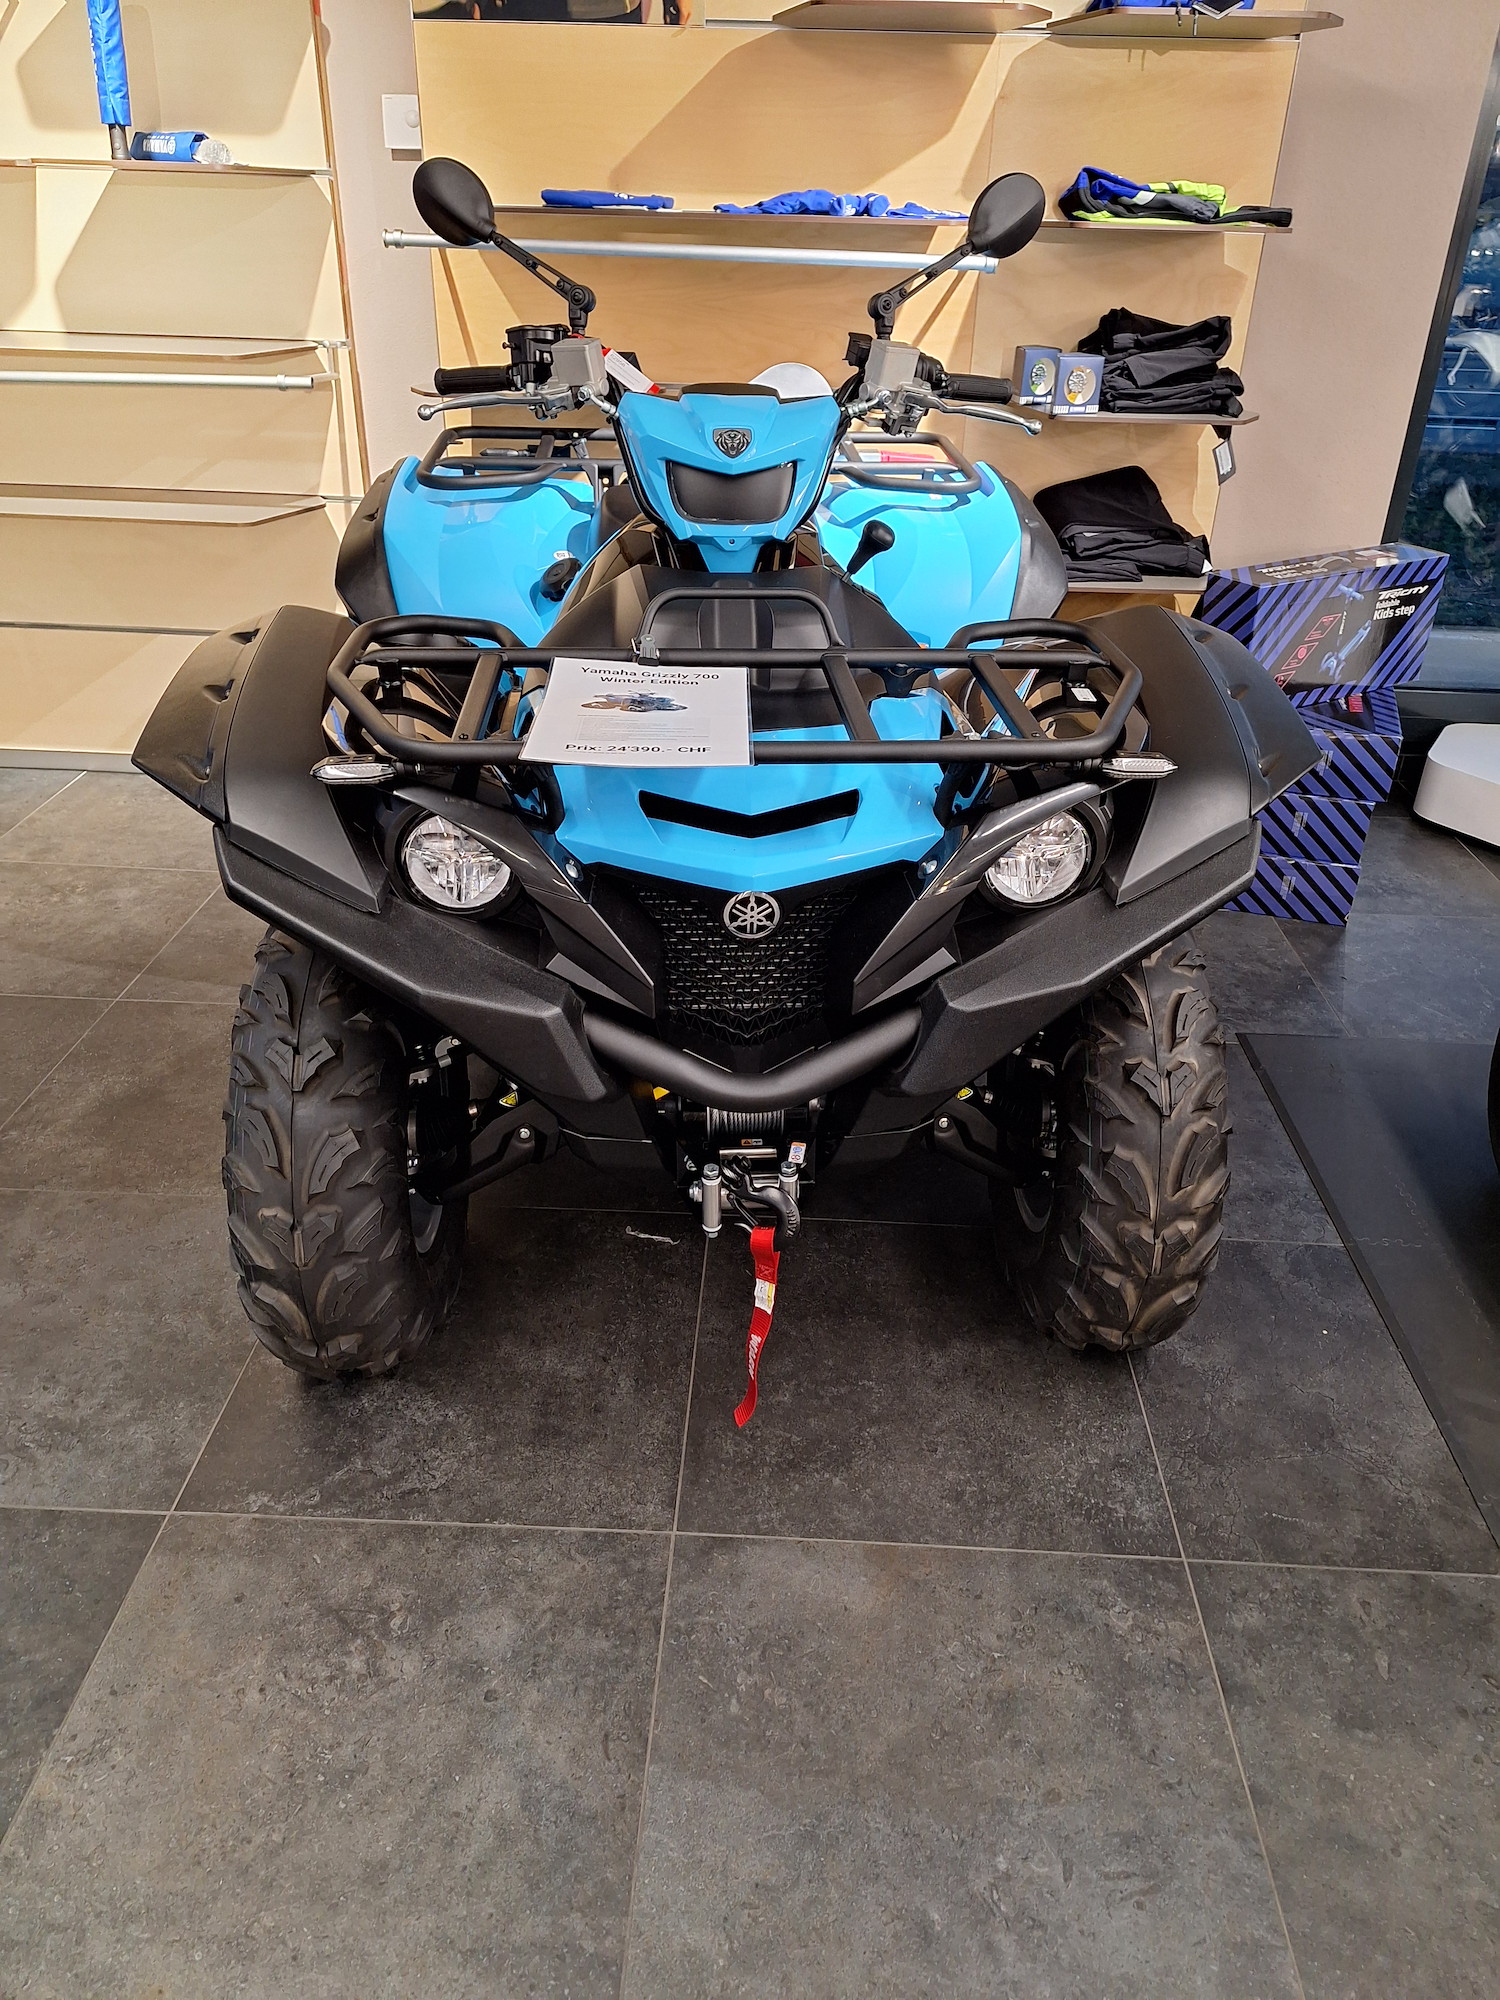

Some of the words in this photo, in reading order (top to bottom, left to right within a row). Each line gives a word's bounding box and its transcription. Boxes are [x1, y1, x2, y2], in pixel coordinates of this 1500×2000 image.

[1373, 607, 1394, 620] Kids
[1394, 605, 1415, 617] step
[581, 667, 637, 676] Yamaha
[641, 671, 689, 679] Grizzly
[600, 676, 645, 684] Winter
[607, 745, 672, 753] 24'390.-
